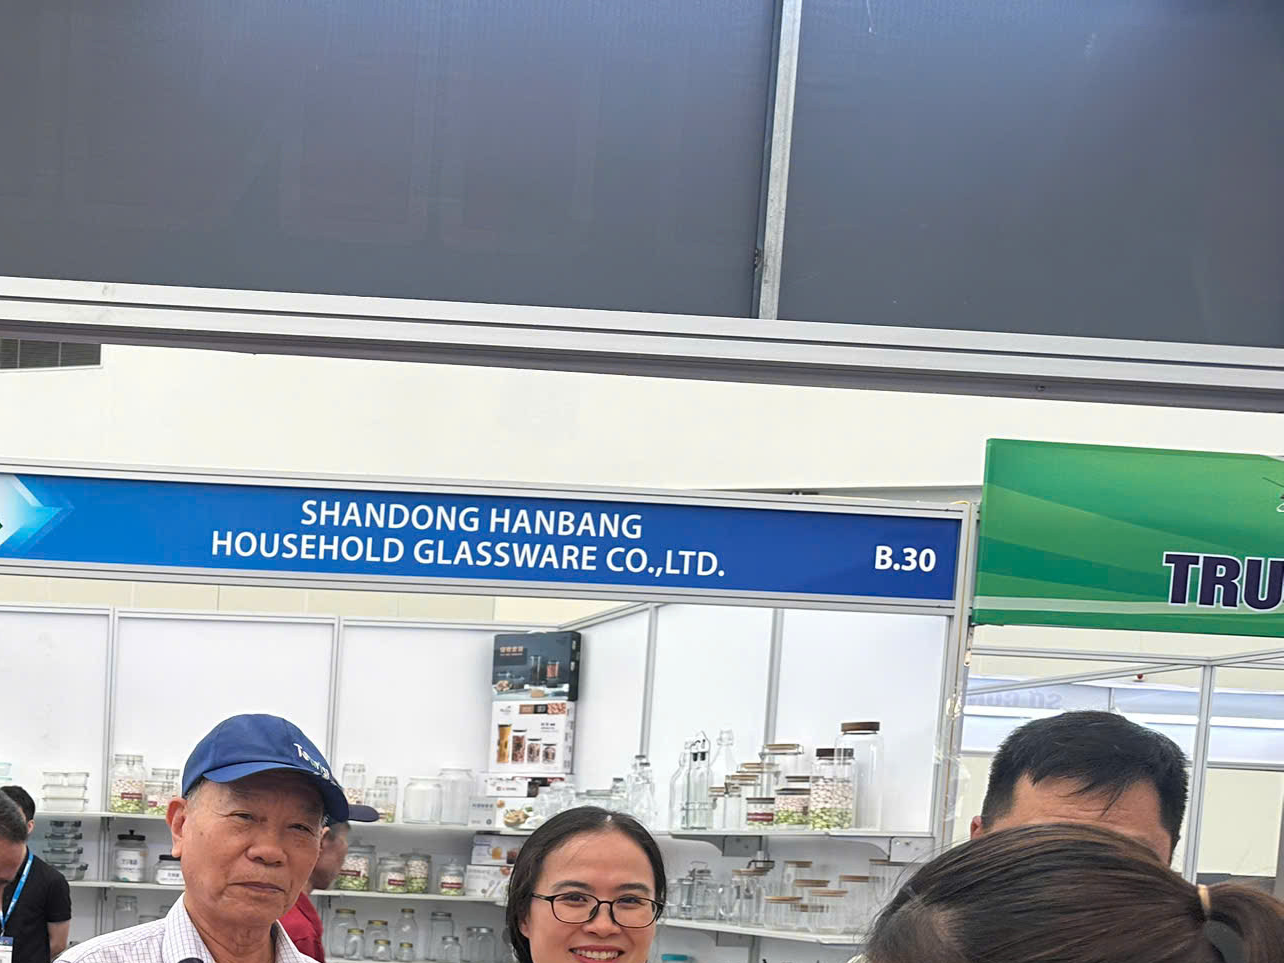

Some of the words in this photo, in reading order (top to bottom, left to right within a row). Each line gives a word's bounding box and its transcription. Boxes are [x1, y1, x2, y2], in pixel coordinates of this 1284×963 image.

[300, 499, 480, 533] SHANDONG
[489, 507, 643, 540] HANBANG
[212, 530, 405, 564] HOUSEHOLD
[413, 538, 597, 572] GLASSWARE
[605, 546, 726, 579] CO.,LTD.
[873, 544, 937, 574] B.30
[1163, 551, 1284, 611] TRU
